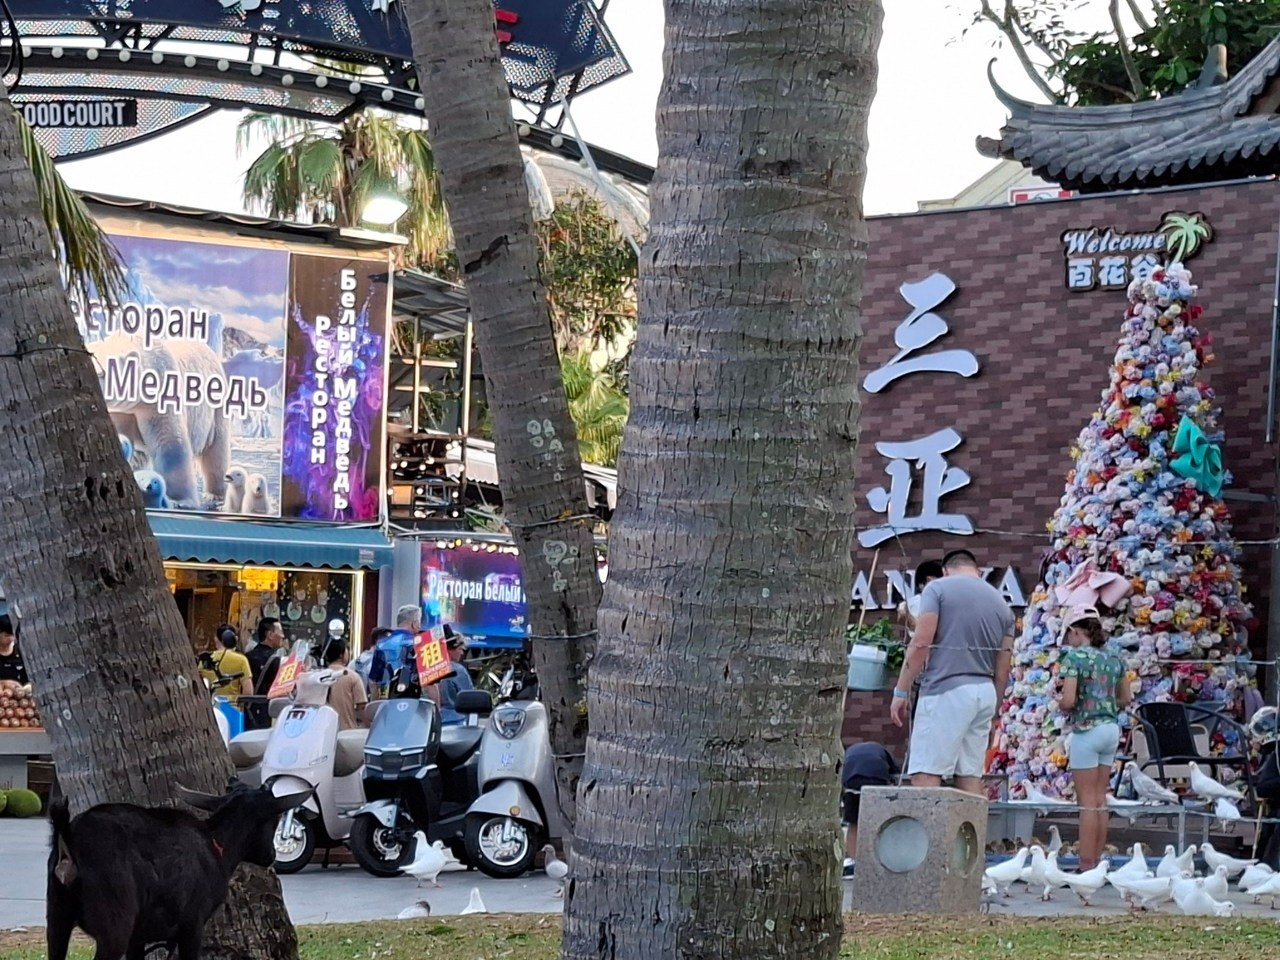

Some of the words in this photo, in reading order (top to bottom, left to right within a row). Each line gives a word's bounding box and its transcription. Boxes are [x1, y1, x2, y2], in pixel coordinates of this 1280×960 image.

[15, 103, 61, 126] OOD
[63, 103, 126, 126] COURT
[1063, 229, 1167, 255] Welcome
[337, 269, 357, 366] Белый
[106, 357, 267, 418] Медведь
[310, 315, 332, 465] Ресторан
[857, 272, 979, 548] 三亚
[333, 377, 357, 510] Медведь
[429, 573, 483, 606] Ресторан
[485, 577, 521, 603] Белый
[420, 641, 444, 668] 租
